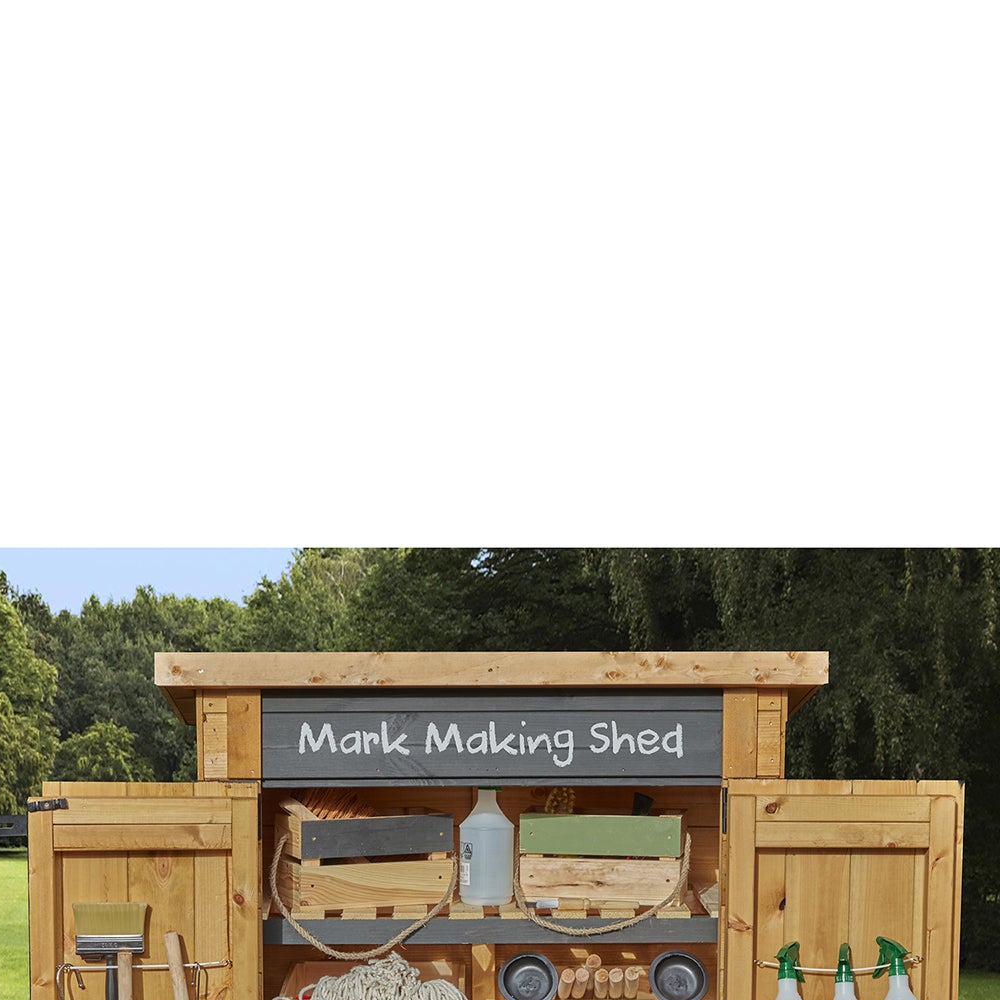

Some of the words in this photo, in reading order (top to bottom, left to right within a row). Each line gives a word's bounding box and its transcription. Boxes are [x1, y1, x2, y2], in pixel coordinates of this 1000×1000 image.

[298, 721, 411, 755] Mark
[425, 721, 574, 767] Making
[589, 721, 684, 759] Shed
